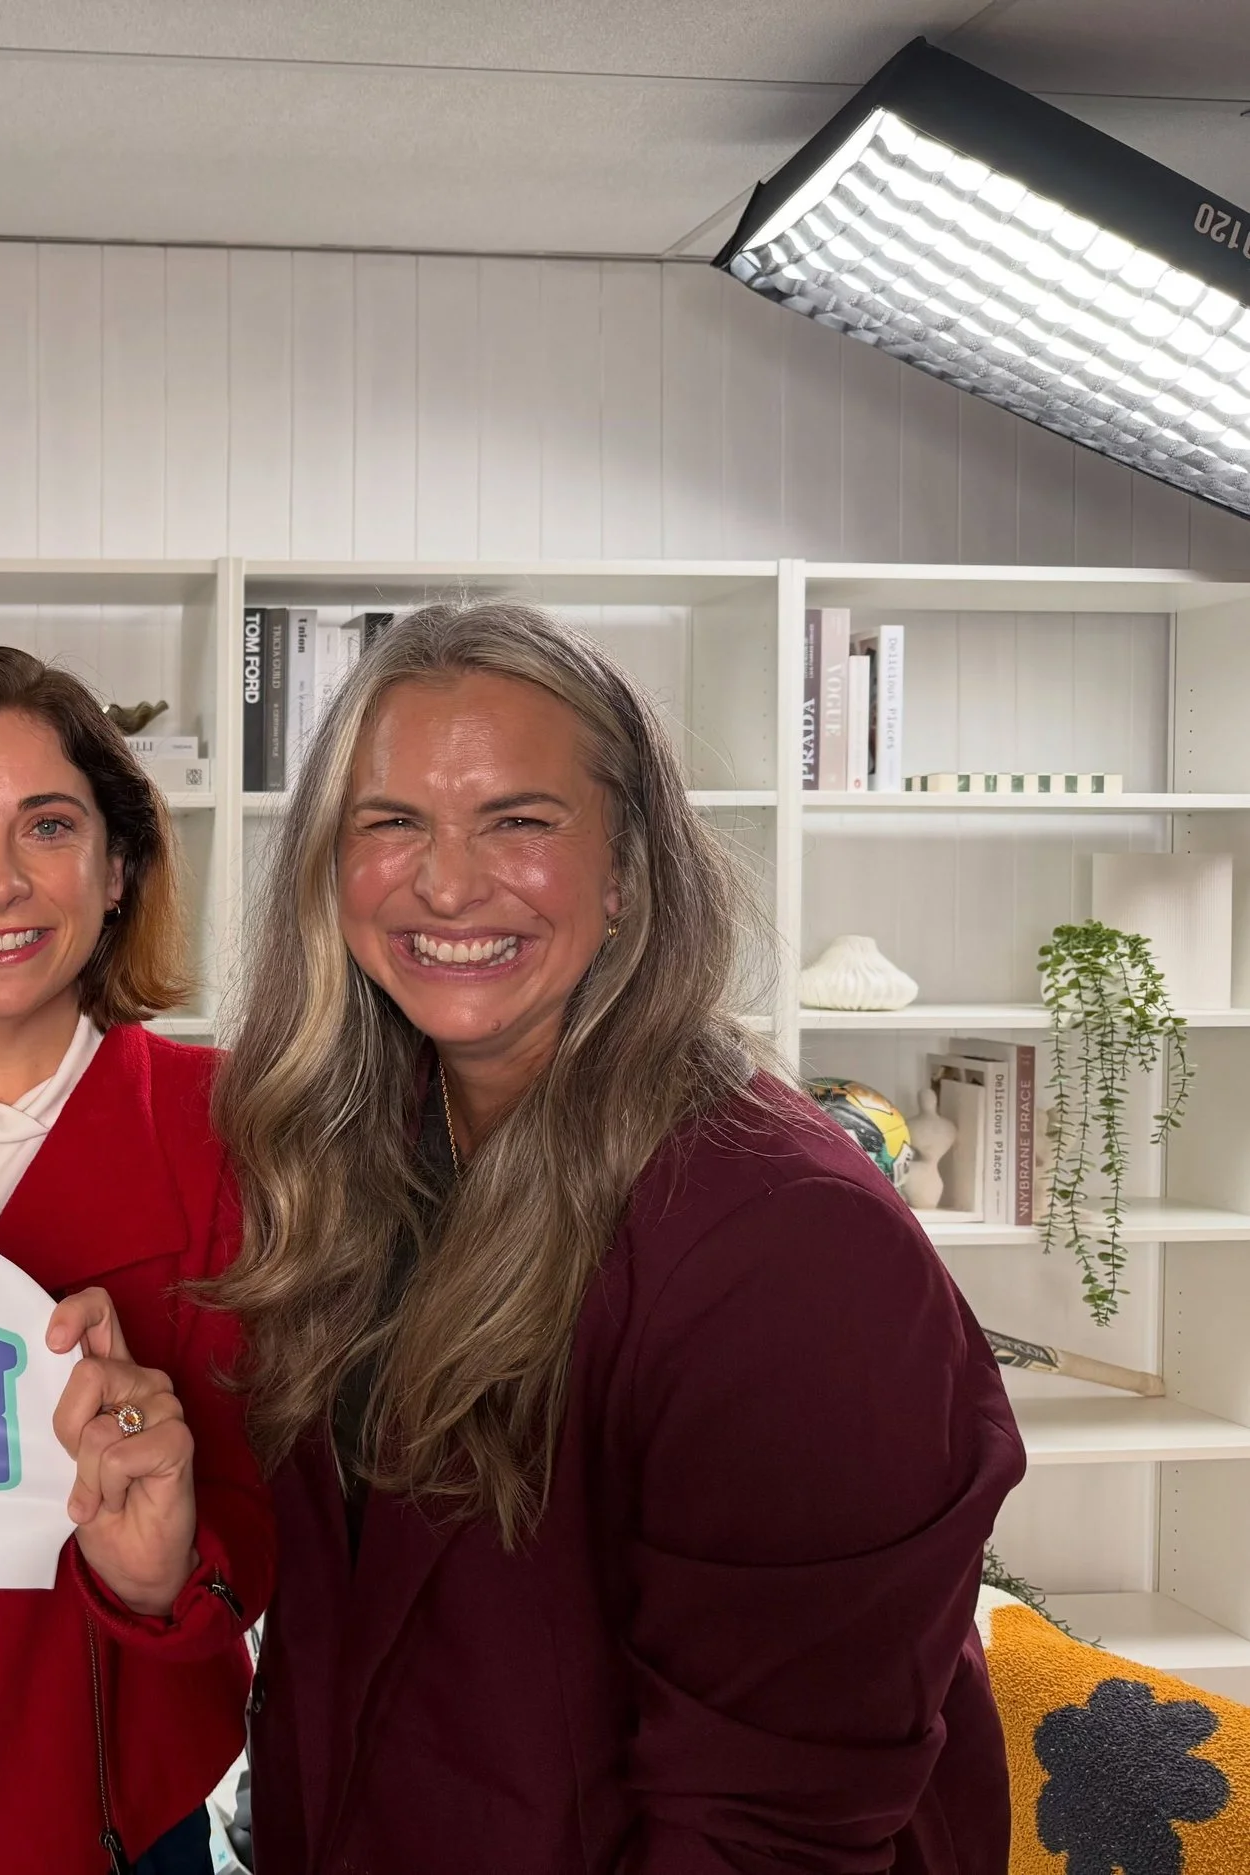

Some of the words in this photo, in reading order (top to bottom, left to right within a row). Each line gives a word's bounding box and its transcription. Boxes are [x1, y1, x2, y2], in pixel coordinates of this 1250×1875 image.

[245, 613, 260, 653] TOM
[272, 625, 281, 658] TRICIA
[245, 656, 260, 704] FORD
[272, 659, 281, 689] GUILD
[886, 637, 898, 702] Delicious
[826, 664, 842, 738] VOGUE
[802, 697, 815, 782] PRADA
[886, 708, 898, 750] Places
[994, 1073, 1004, 1135] Delicious
[1020, 1080, 1031, 1132] PRACE
[993, 1141, 1004, 1182] Places
[1019, 1138, 1031, 1217] WYBRANE
